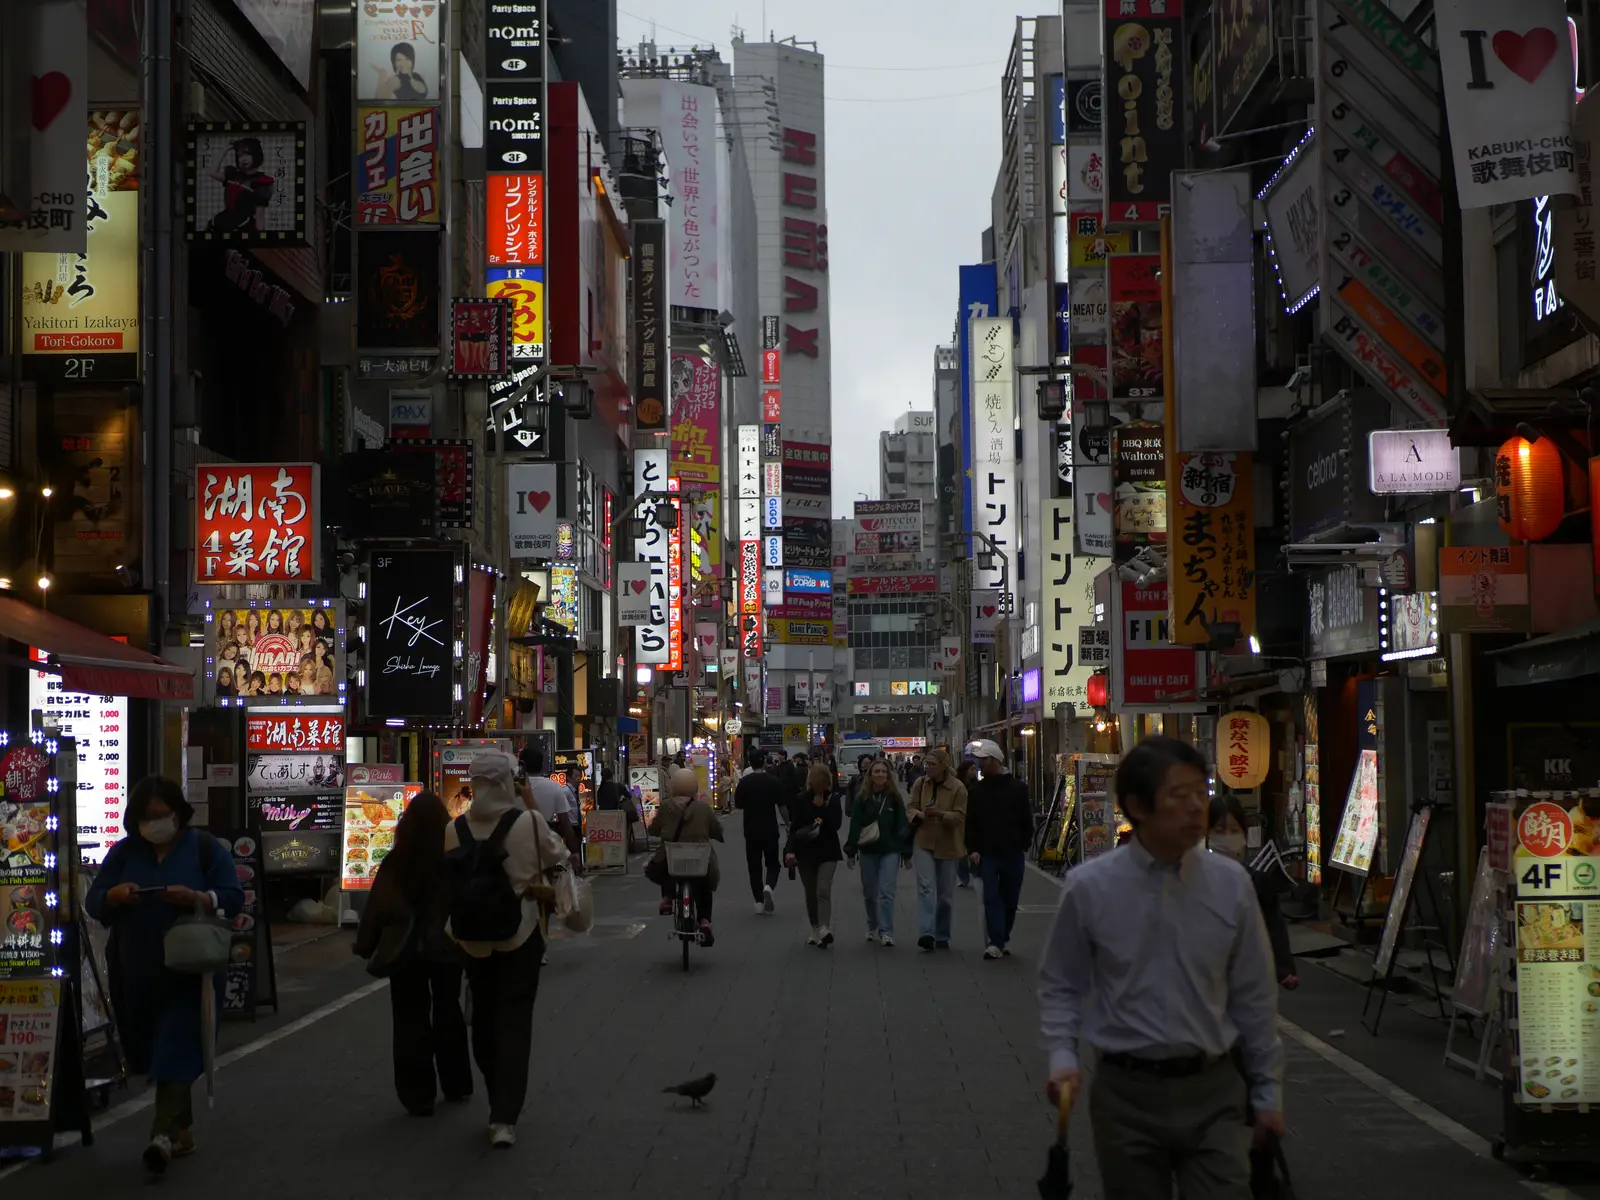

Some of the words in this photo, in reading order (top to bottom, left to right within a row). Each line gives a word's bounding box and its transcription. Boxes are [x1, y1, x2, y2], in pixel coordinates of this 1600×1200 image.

[492, 5, 511, 14] Party
[512, 5, 536, 14] Space
[1329, 14, 1348, 32] 7
[507, 61, 520, 69] 4F
[1460, 30, 1494, 90] I
[1331, 60, 1348, 77] 6
[493, 97, 512, 106] Party
[513, 97, 537, 106] Space
[1332, 102, 1350, 120] 5
[364, 110, 387, 190] カフェ
[508, 153, 521, 161] 3F
[1334, 148, 1351, 163] 4
[399, 111, 434, 222] 出会い
[1470, 151, 1575, 185] 歌舞伎町
[681, 94, 700, 299] 出会いで、世界に色がついた
[1334, 189, 1351, 207] 3
[504, 176, 522, 264] リフレッシュ
[528, 230, 538, 260] ホステル
[1333, 232, 1351, 250] 2
[489, 254, 501, 263] 2F
[506, 268, 526, 279] 1F
[641, 243, 656, 387] 個室ダイニング居酒屋
[1074, 303, 1095, 316] MEAT
[23, 315, 79, 330] Yakitori
[84, 315, 138, 333] Izakaya
[1334, 316, 1359, 341] B1
[40, 335, 116, 348] Tori-Gokoro
[64, 358, 96, 379] 2F
[512, 364, 539, 387] Space
[1128, 387, 1156, 397] 3F
[520, 432, 534, 440] B1
[1122, 439, 1142, 449] BBQ
[1144, 438, 1162, 448] 東京
[1120, 450, 1165, 462] Walton's
[1393, 471, 1408, 482] LA
[1412, 471, 1453, 482] MODE
[1183, 466, 1233, 506] 新宿の
[203, 467, 308, 528] 湖南
[517, 491, 527, 514] I
[1085, 492, 1096, 516] I
[769, 498, 778, 525] GiGO
[514, 541, 551, 550] 歌舞伎町
[769, 538, 778, 564] GiGO
[202, 530, 224, 577] 4F
[377, 557, 393, 568] 3F
[1183, 511, 1220, 632] まっちゃん
[861, 575, 935, 586] ゴールドラッシュ
[622, 579, 631, 597] I
[1050, 507, 1073, 676] トントン
[1135, 590, 1159, 601] OPEN
[975, 605, 982, 619] I
[379, 595, 444, 647] Key
[1130, 674, 1164, 686] ONLINE
[1166, 674, 1189, 686] CAFE
[99, 696, 114, 704] 780
[99, 710, 119, 719] 1,000
[99, 725, 119, 733] 1,200
[99, 740, 119, 748] 1,150
[249, 734, 262, 743] 4F
[1229, 717, 1250, 778] 鉄なべ餃子
[98, 753, 119, 761] 2,000
[104, 768, 119, 776] 780
[104, 783, 119, 791] 680
[104, 797, 119, 805] 850
[104, 811, 119, 819] 780
[99, 825, 119, 834] 1,480
[1521, 863, 1563, 889] 4F
[1523, 948, 1581, 962] 野菜巻き串
